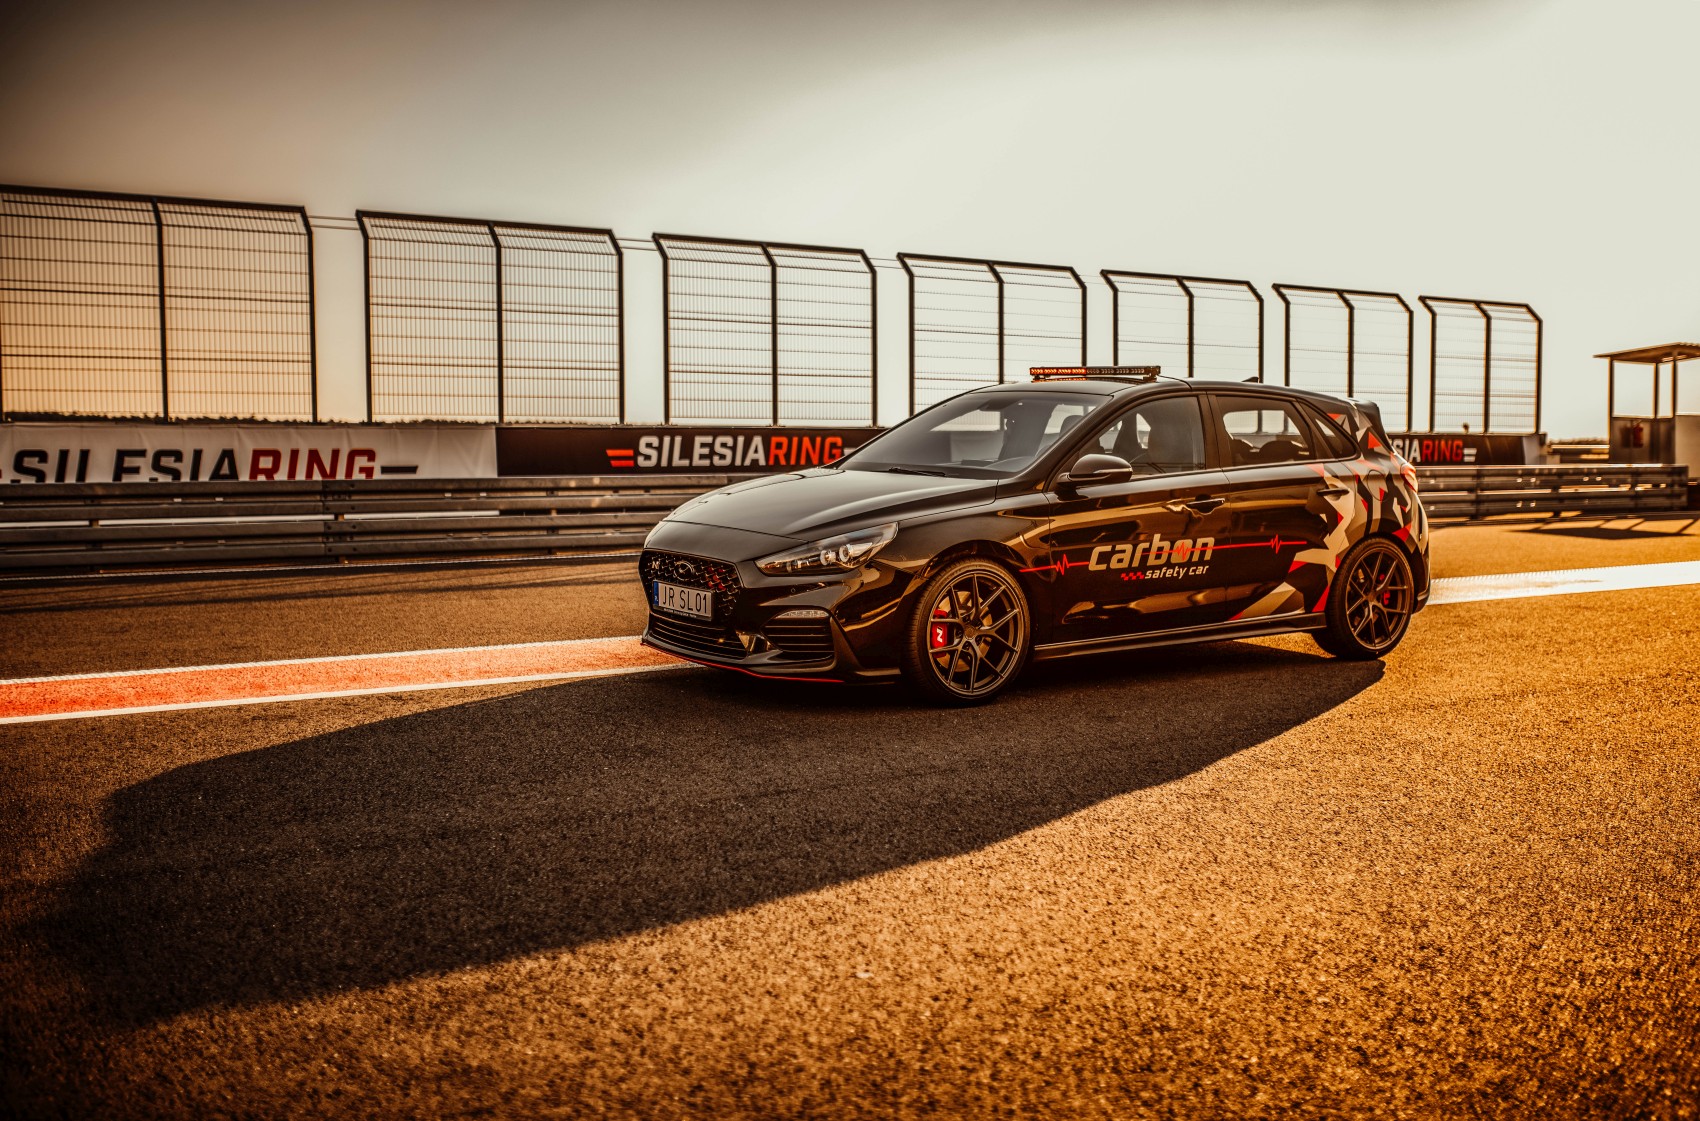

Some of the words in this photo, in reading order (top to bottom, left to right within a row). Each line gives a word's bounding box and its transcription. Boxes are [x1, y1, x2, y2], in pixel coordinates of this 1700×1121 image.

[637, 435, 845, 467] SILESIARING
[1391, 438, 1463, 462] SIARING
[1088, 533, 1215, 571] carbon
[1145, 567, 1187, 579] safety
[1189, 565, 1208, 575] car
[663, 586, 675, 607] JR
[679, 589, 707, 614] SL01
